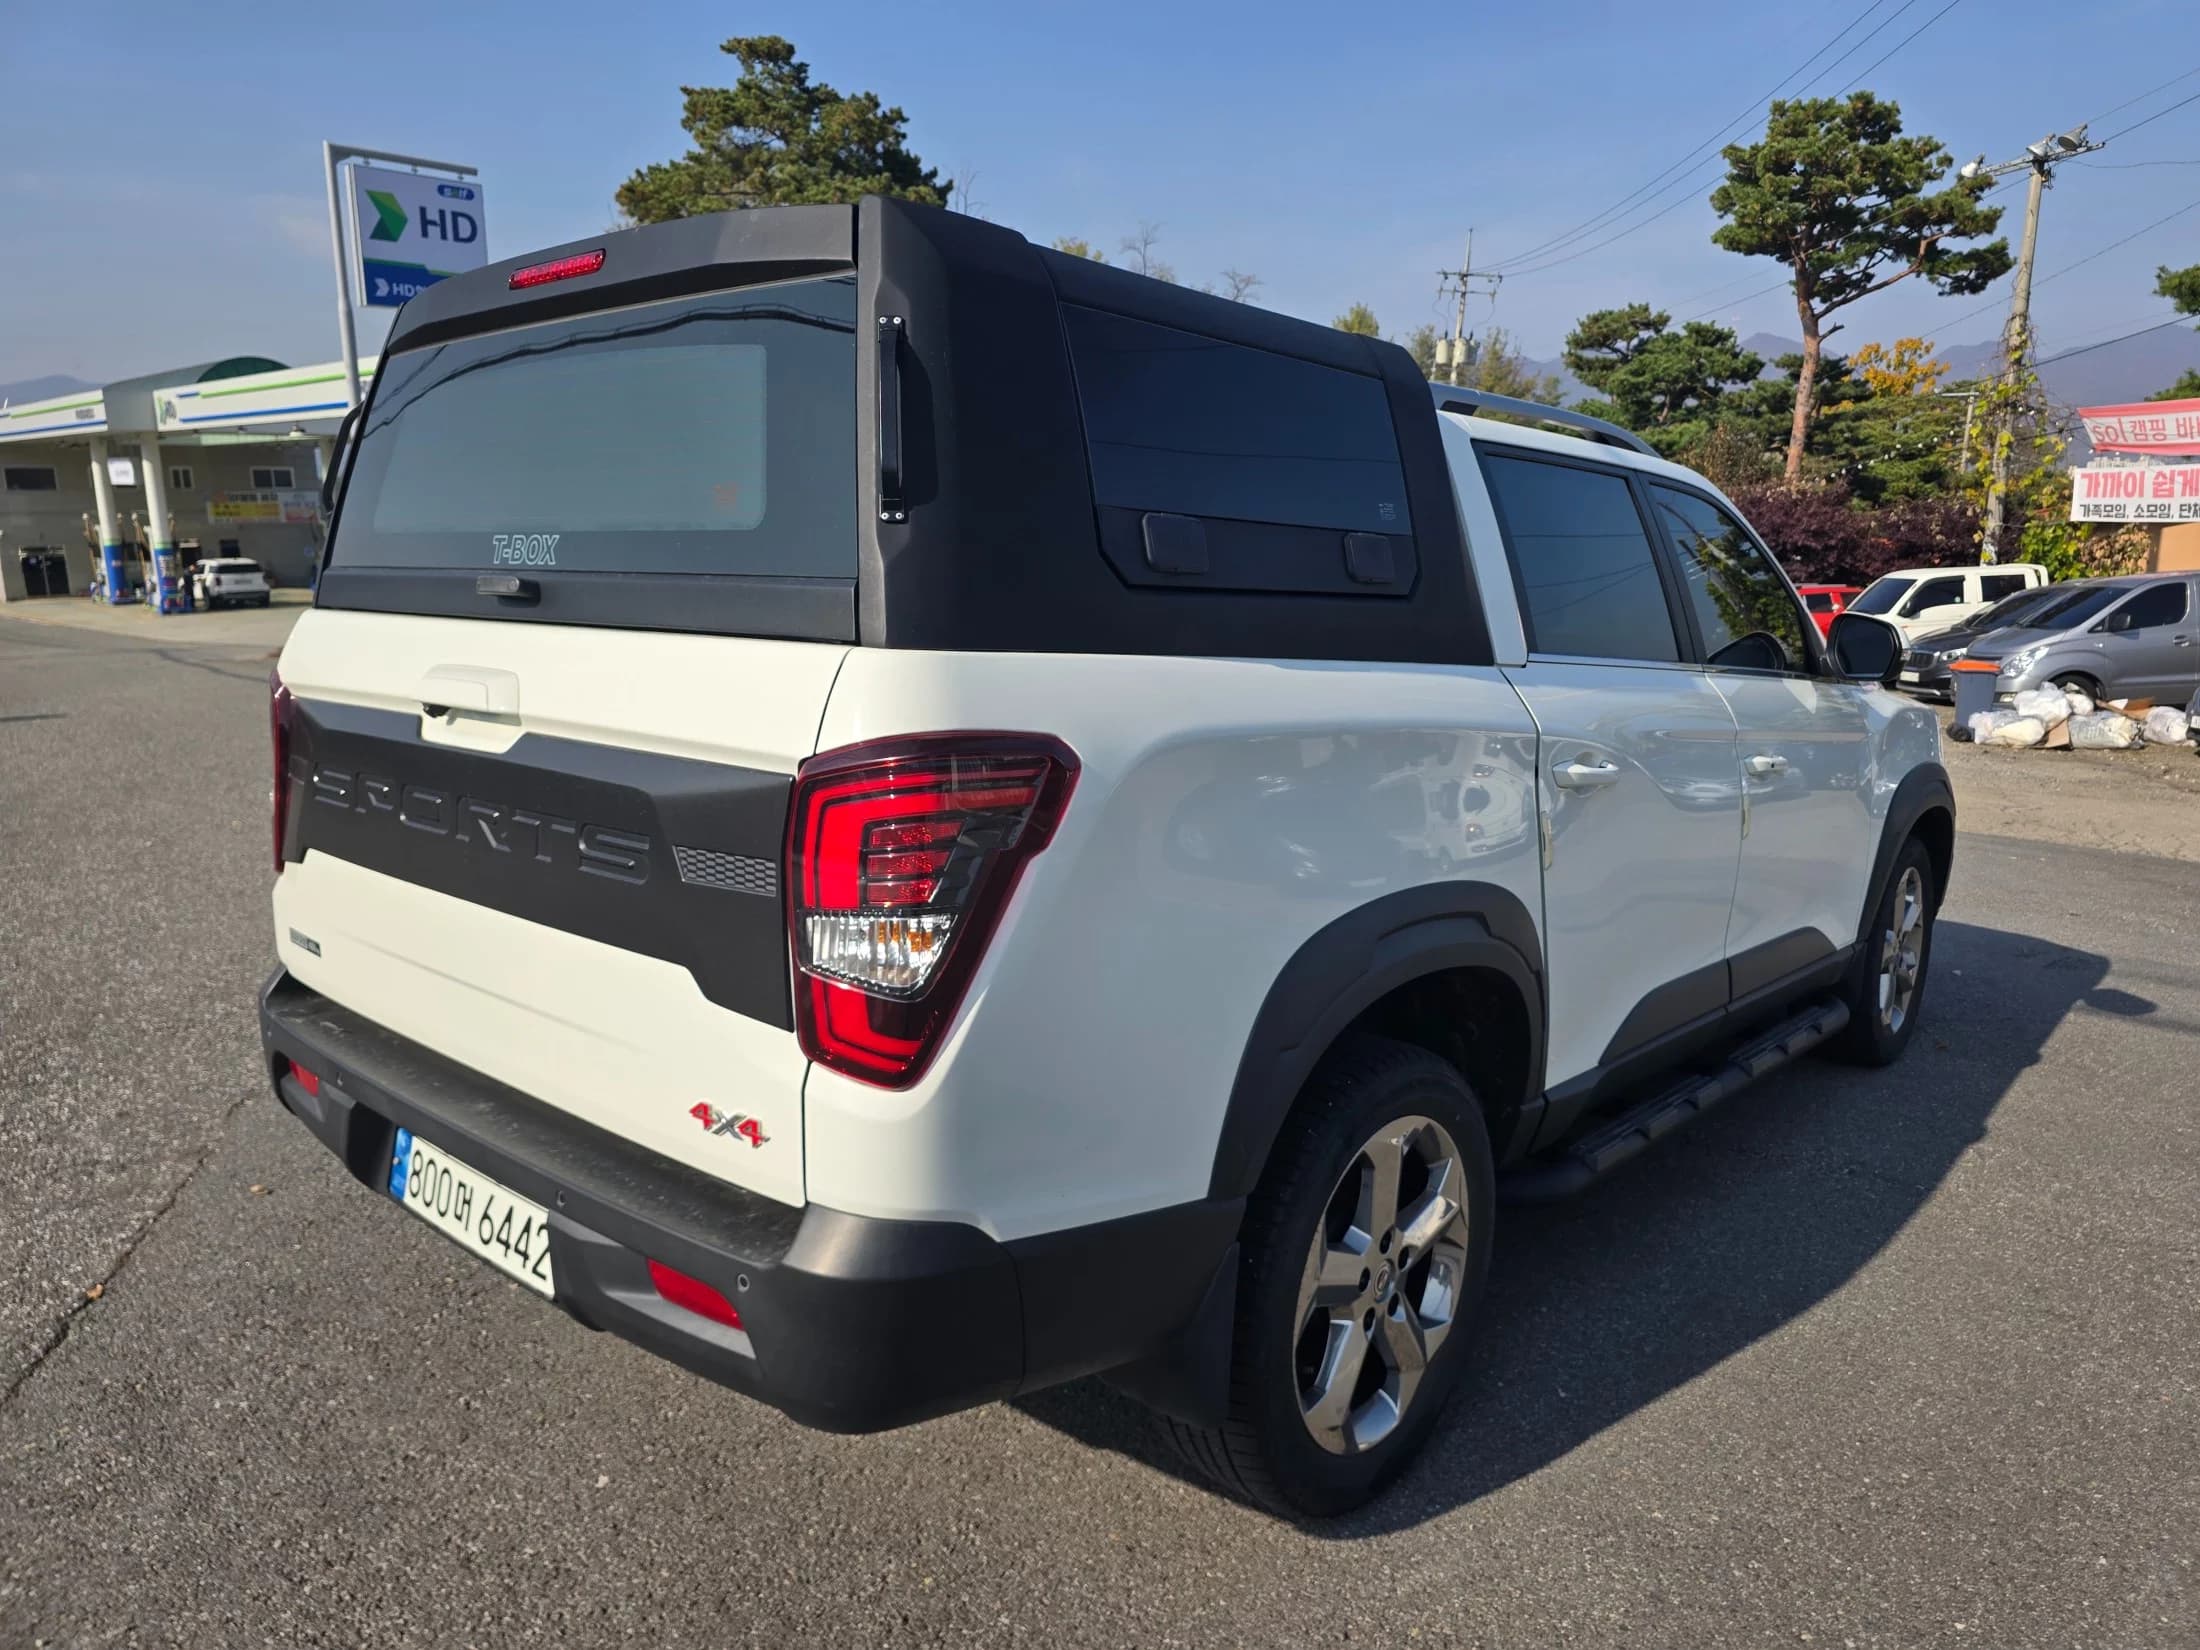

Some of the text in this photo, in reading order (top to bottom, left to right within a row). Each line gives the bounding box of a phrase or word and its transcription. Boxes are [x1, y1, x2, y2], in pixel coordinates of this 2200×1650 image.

[419, 206, 478, 243] HD
[2130, 418, 2167, 441] 캠핑
[2081, 468, 2200, 498] 가까이 쉽게
[2080, 504, 2129, 519] 가족모임,
[2134, 503, 2174, 519] 소모임,
[493, 535, 560, 565] T-BOX
[312, 761, 650, 886] SPORTS
[409, 1150, 550, 1281] 800머 6442
